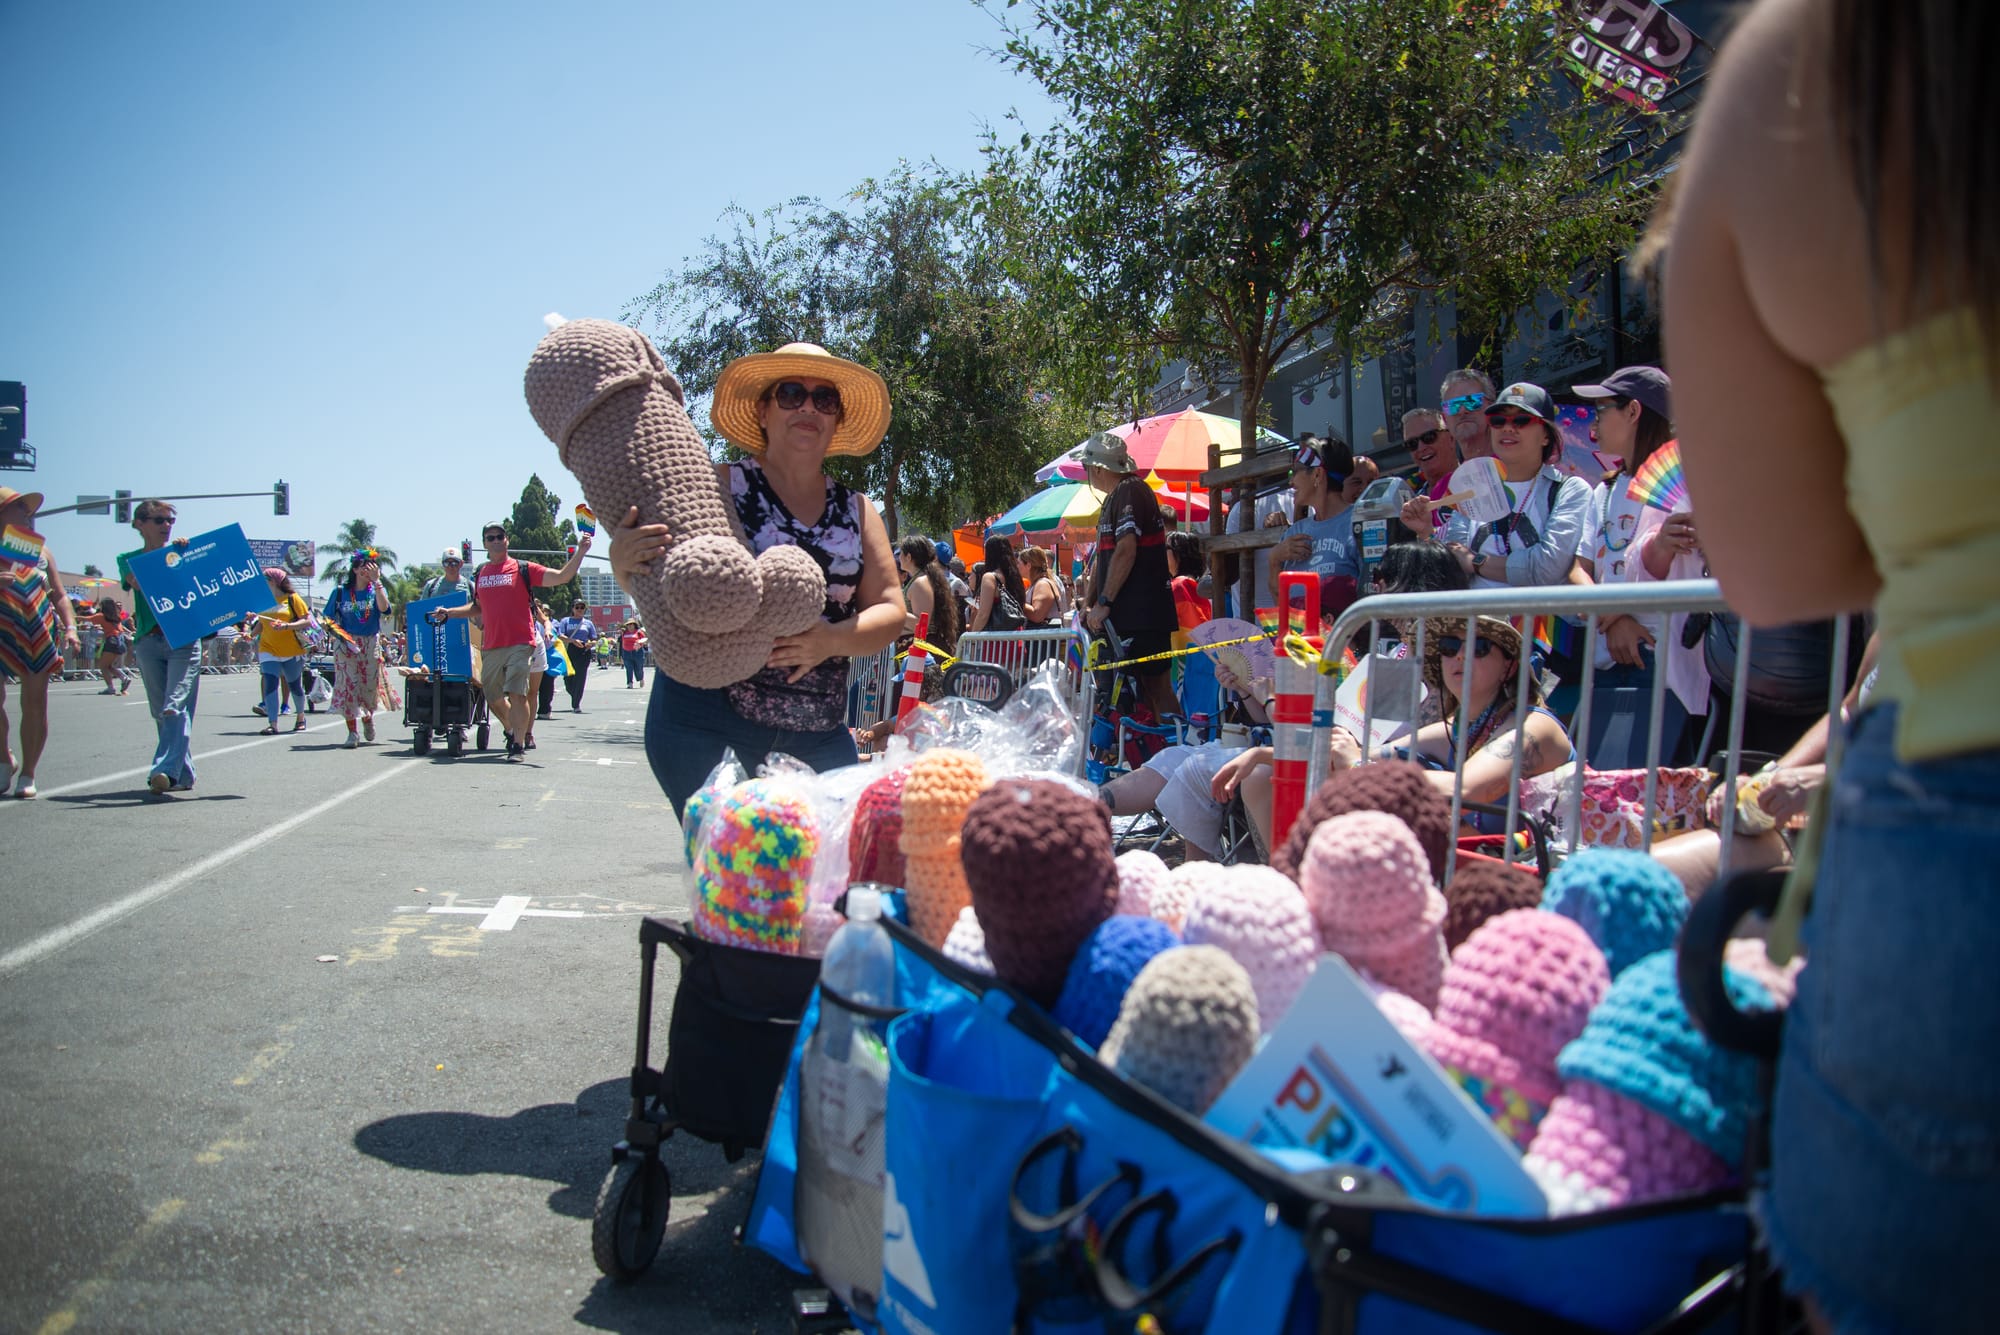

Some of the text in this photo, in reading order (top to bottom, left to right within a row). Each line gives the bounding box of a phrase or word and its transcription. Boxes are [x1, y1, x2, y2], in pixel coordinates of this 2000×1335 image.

[3, 533, 41, 558] PRIDE
[220, 558, 259, 586] العدالة
[150, 595, 175, 613] هنا
[178, 591, 197, 609] من
[1273, 1064, 1404, 1183] PRI
